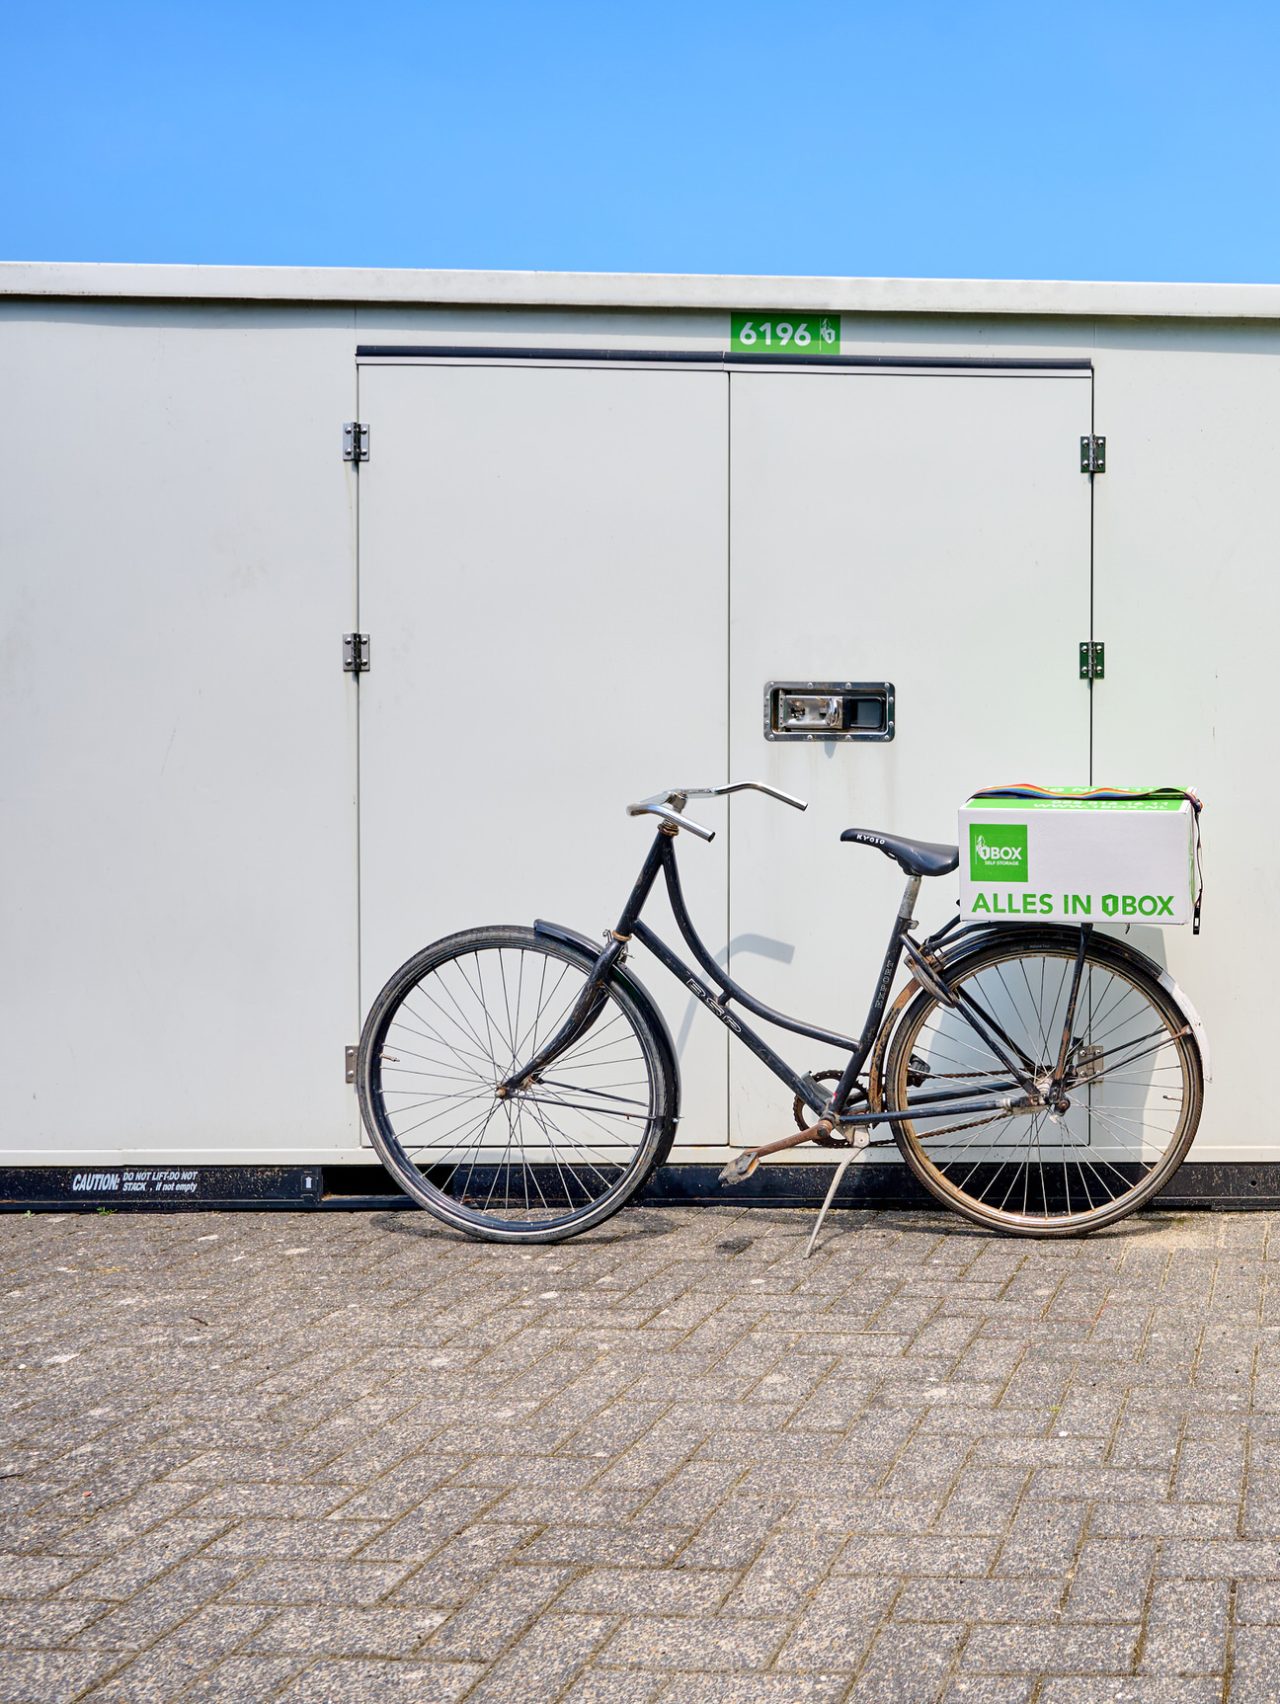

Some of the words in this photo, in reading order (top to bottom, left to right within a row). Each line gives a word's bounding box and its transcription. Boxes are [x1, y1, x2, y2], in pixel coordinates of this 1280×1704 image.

[740, 322, 811, 346] 6196
[972, 893, 1053, 914] ALLES
[1063, 894, 1091, 914] IN
[874, 960, 894, 1009] EXPORT
[73, 1174, 119, 1191] CAUTION:
[123, 1172, 134, 1181] DO
[135, 1172, 151, 1181] NOT
[181, 1171, 198, 1181] NOT
[123, 1182, 146, 1192] STACK
[162, 1182, 175, 1191] not
[175, 1182, 197, 1193] empty
